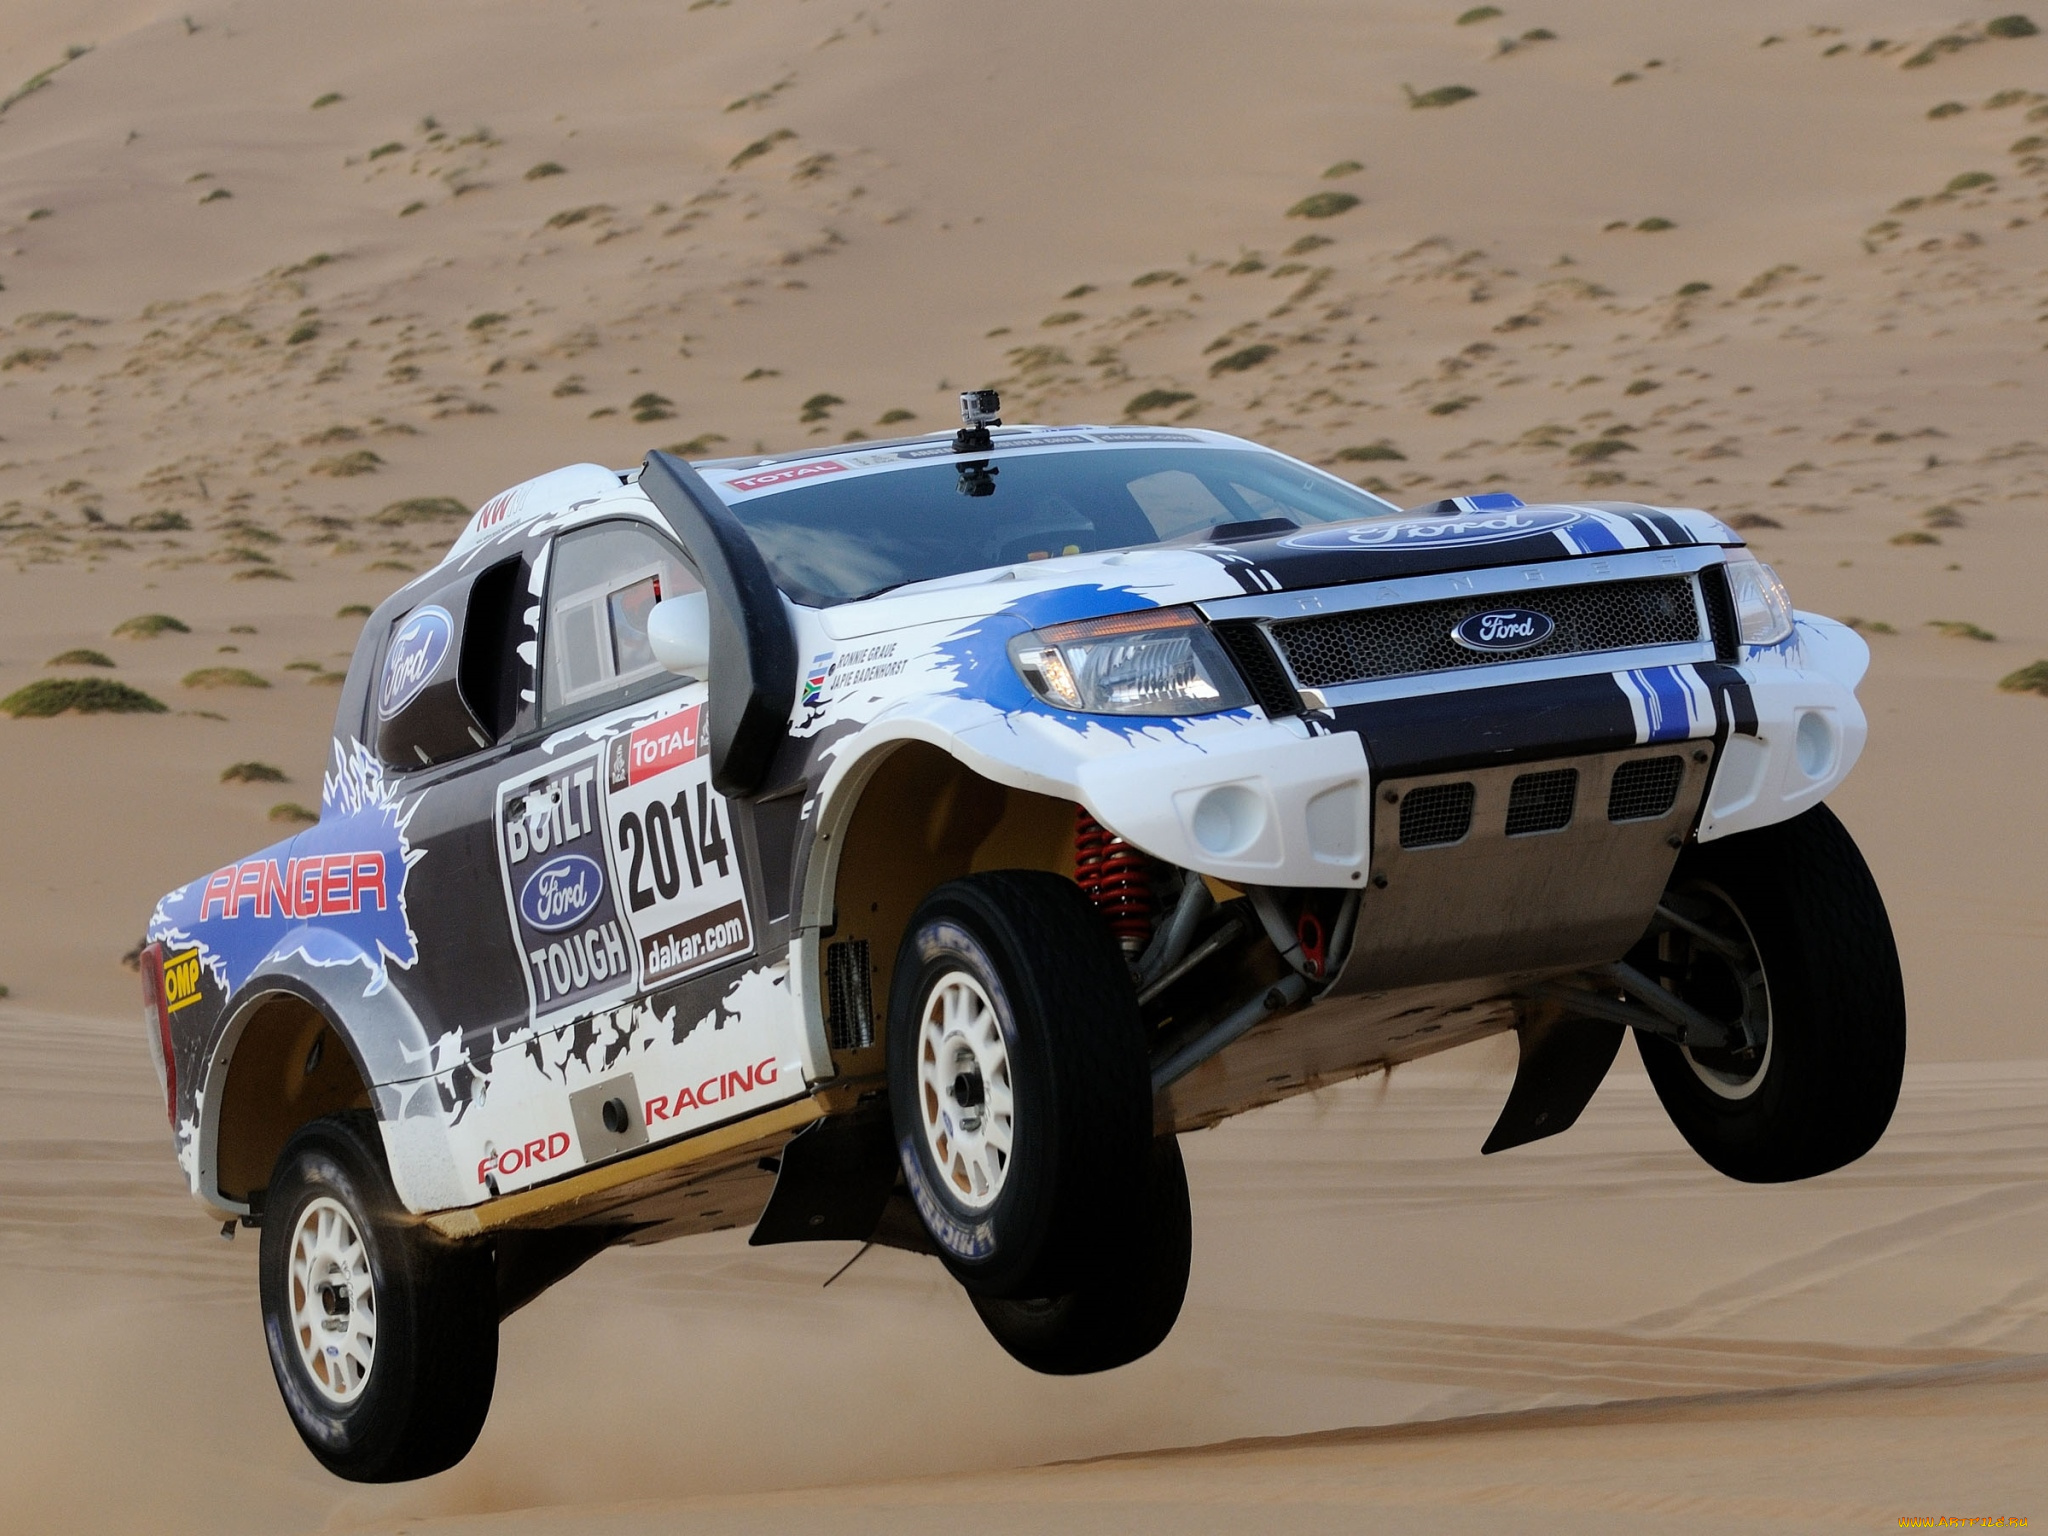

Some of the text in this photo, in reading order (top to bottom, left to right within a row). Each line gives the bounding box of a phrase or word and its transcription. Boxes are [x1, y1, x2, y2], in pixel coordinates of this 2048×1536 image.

[733, 461, 839, 487] TOTAL
[1347, 511, 1535, 545] Ford
[836, 642, 898, 670] RONNIE GRAUE
[1478, 613, 1535, 642] Ford
[383, 623, 434, 707] Ford
[830, 659, 909, 691] JAPIE BADENHORST
[632, 726, 695, 767] TOTAL
[506, 766, 594, 864] BUILT
[618, 781, 730, 914] 2014
[199, 850, 388, 923] RANGER
[537, 864, 588, 922] Ford
[529, 919, 628, 1002] TOUGH
[648, 916, 744, 975] dakar.com
[164, 959, 201, 1003] OMP
[477, 1056, 778, 1186] FORD RACING
